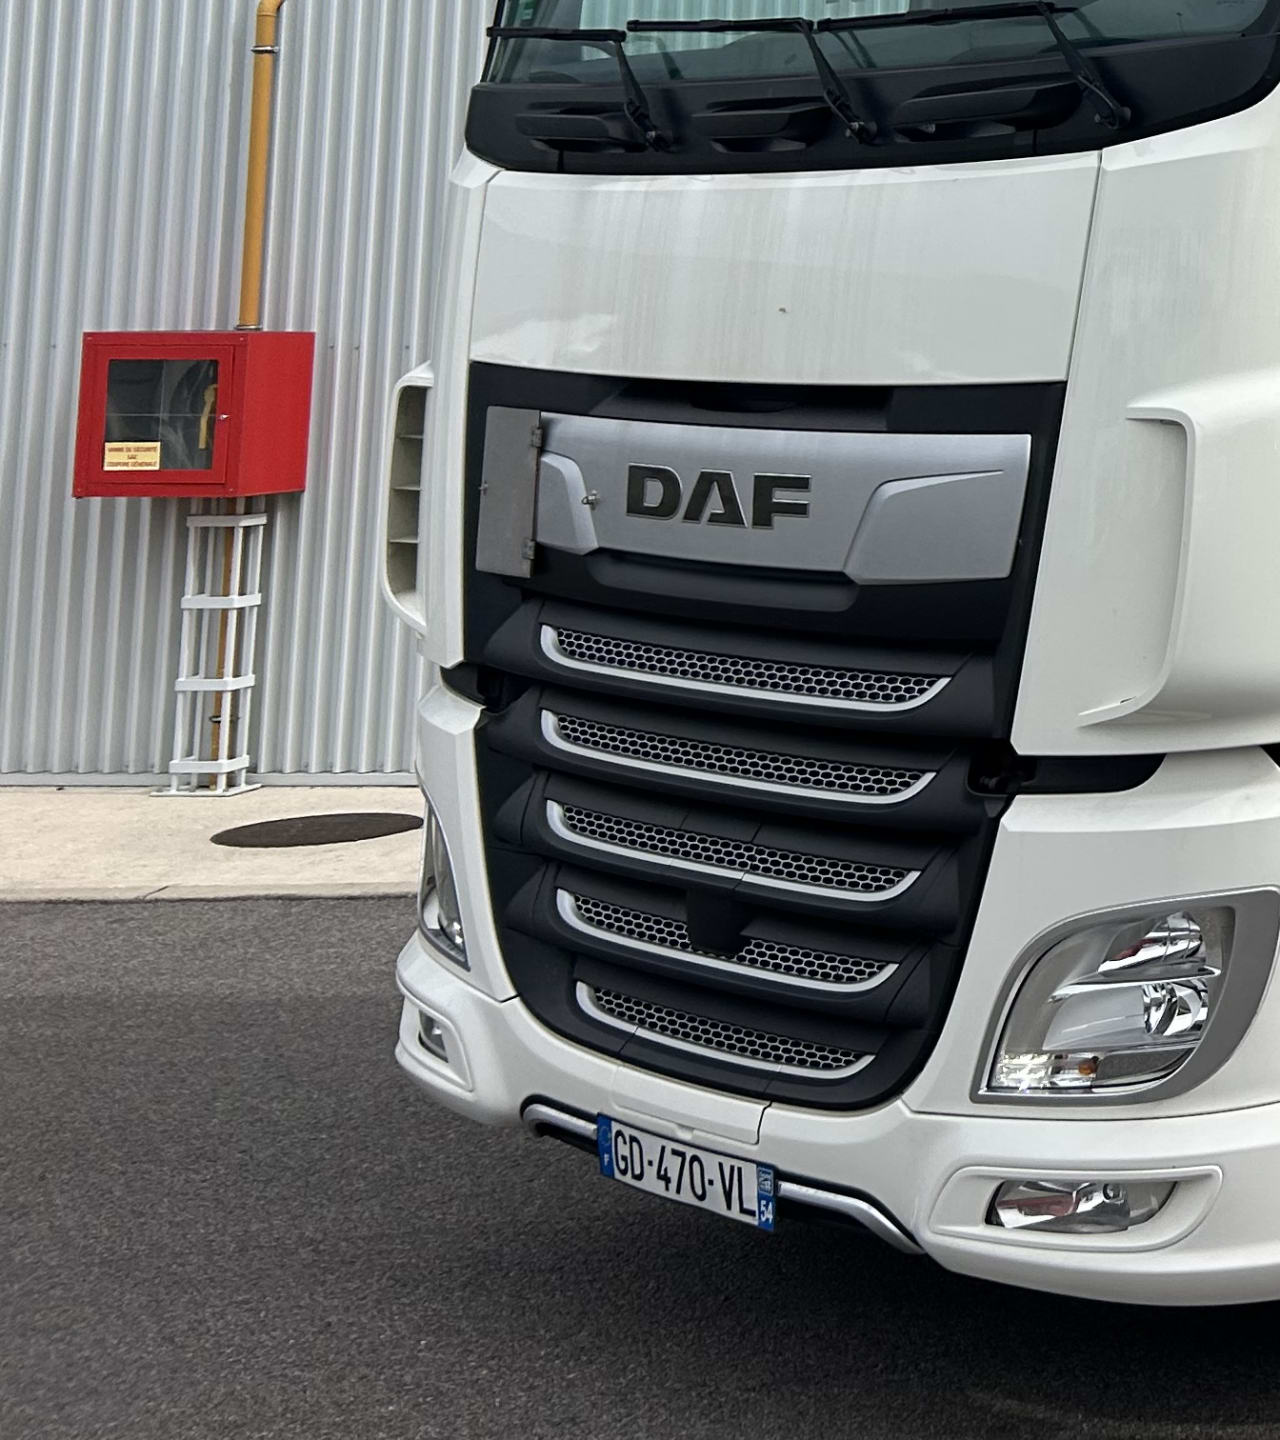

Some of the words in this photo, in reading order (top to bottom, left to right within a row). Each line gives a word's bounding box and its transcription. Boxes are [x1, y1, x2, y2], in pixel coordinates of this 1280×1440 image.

[626, 462, 812, 530] DAF
[613, 1128, 757, 1218] GD-470-VL
[759, 1199, 774, 1224] 54
